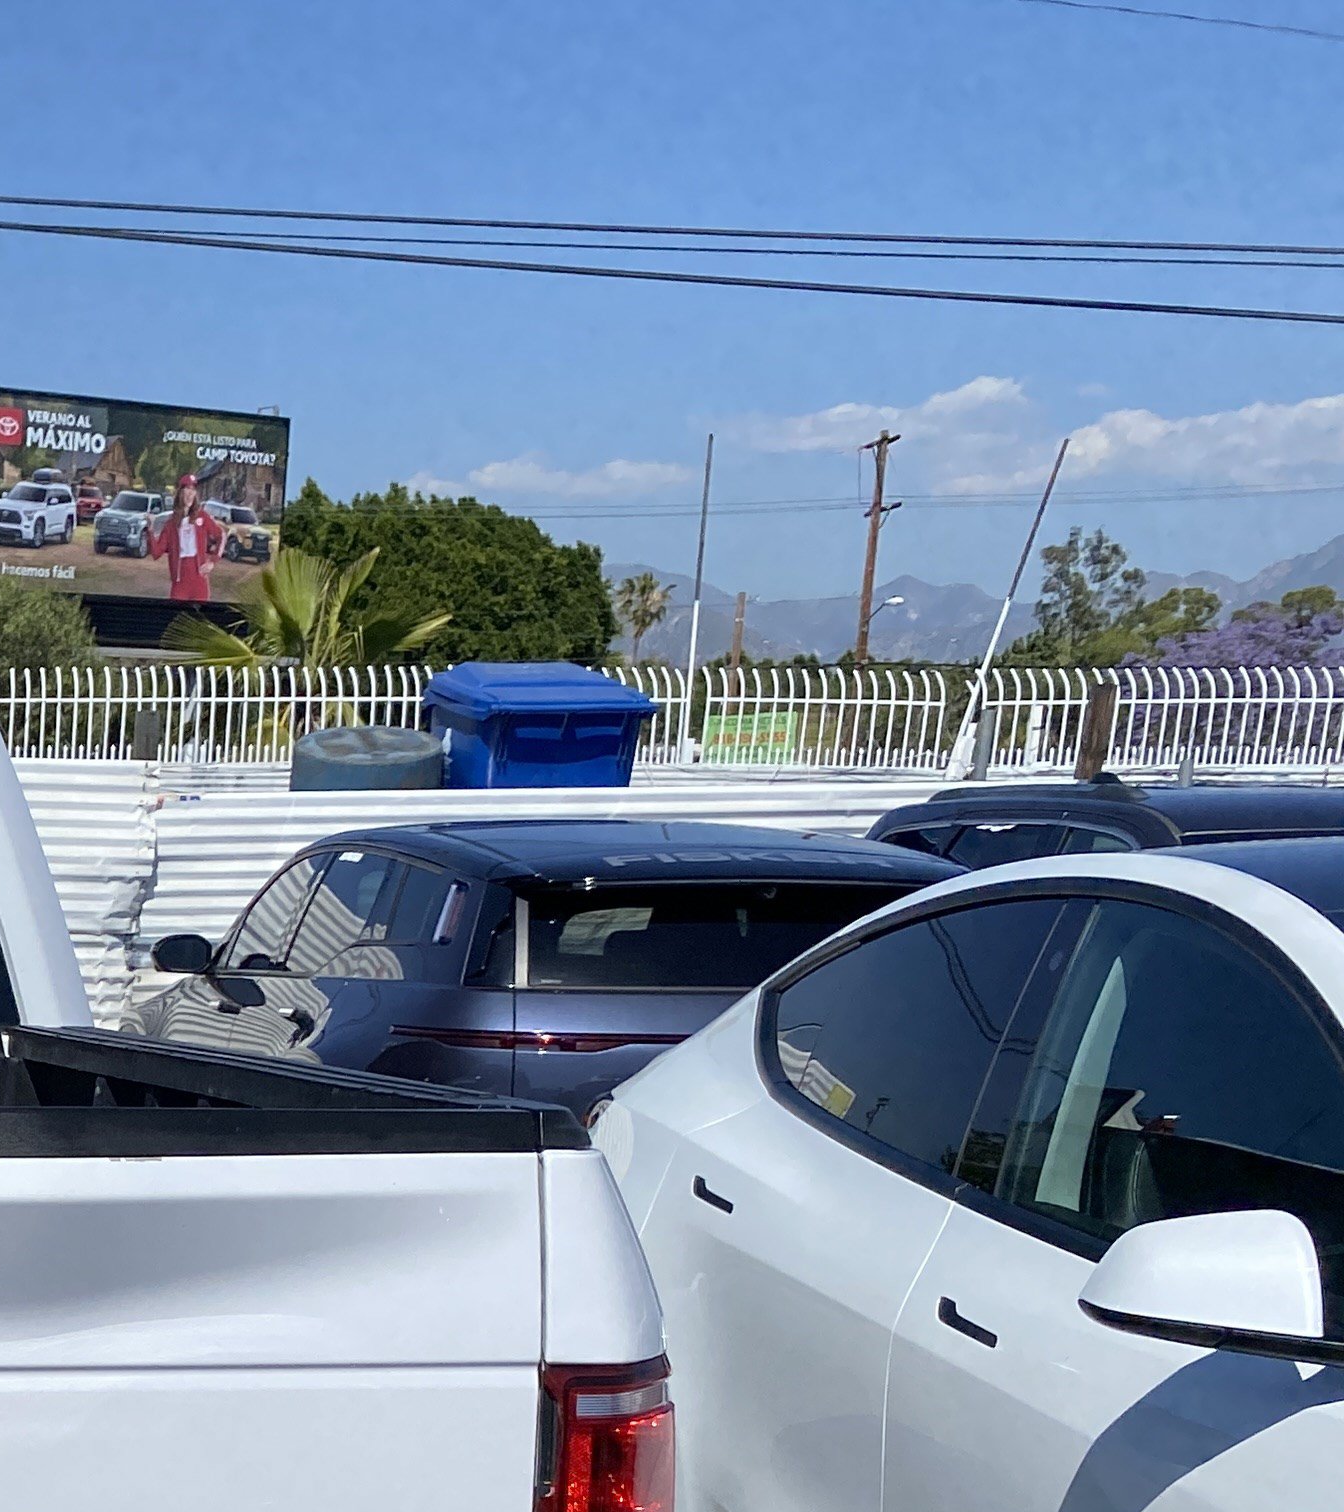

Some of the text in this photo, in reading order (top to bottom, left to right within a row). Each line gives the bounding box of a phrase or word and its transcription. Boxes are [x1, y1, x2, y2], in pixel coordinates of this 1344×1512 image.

[27, 409, 92, 429] VERANO AL
[26, 424, 106, 454] MÁXIMO
[196, 446, 276, 466] CAMP TOYOTA?
[2, 562, 50, 578] hacemos
